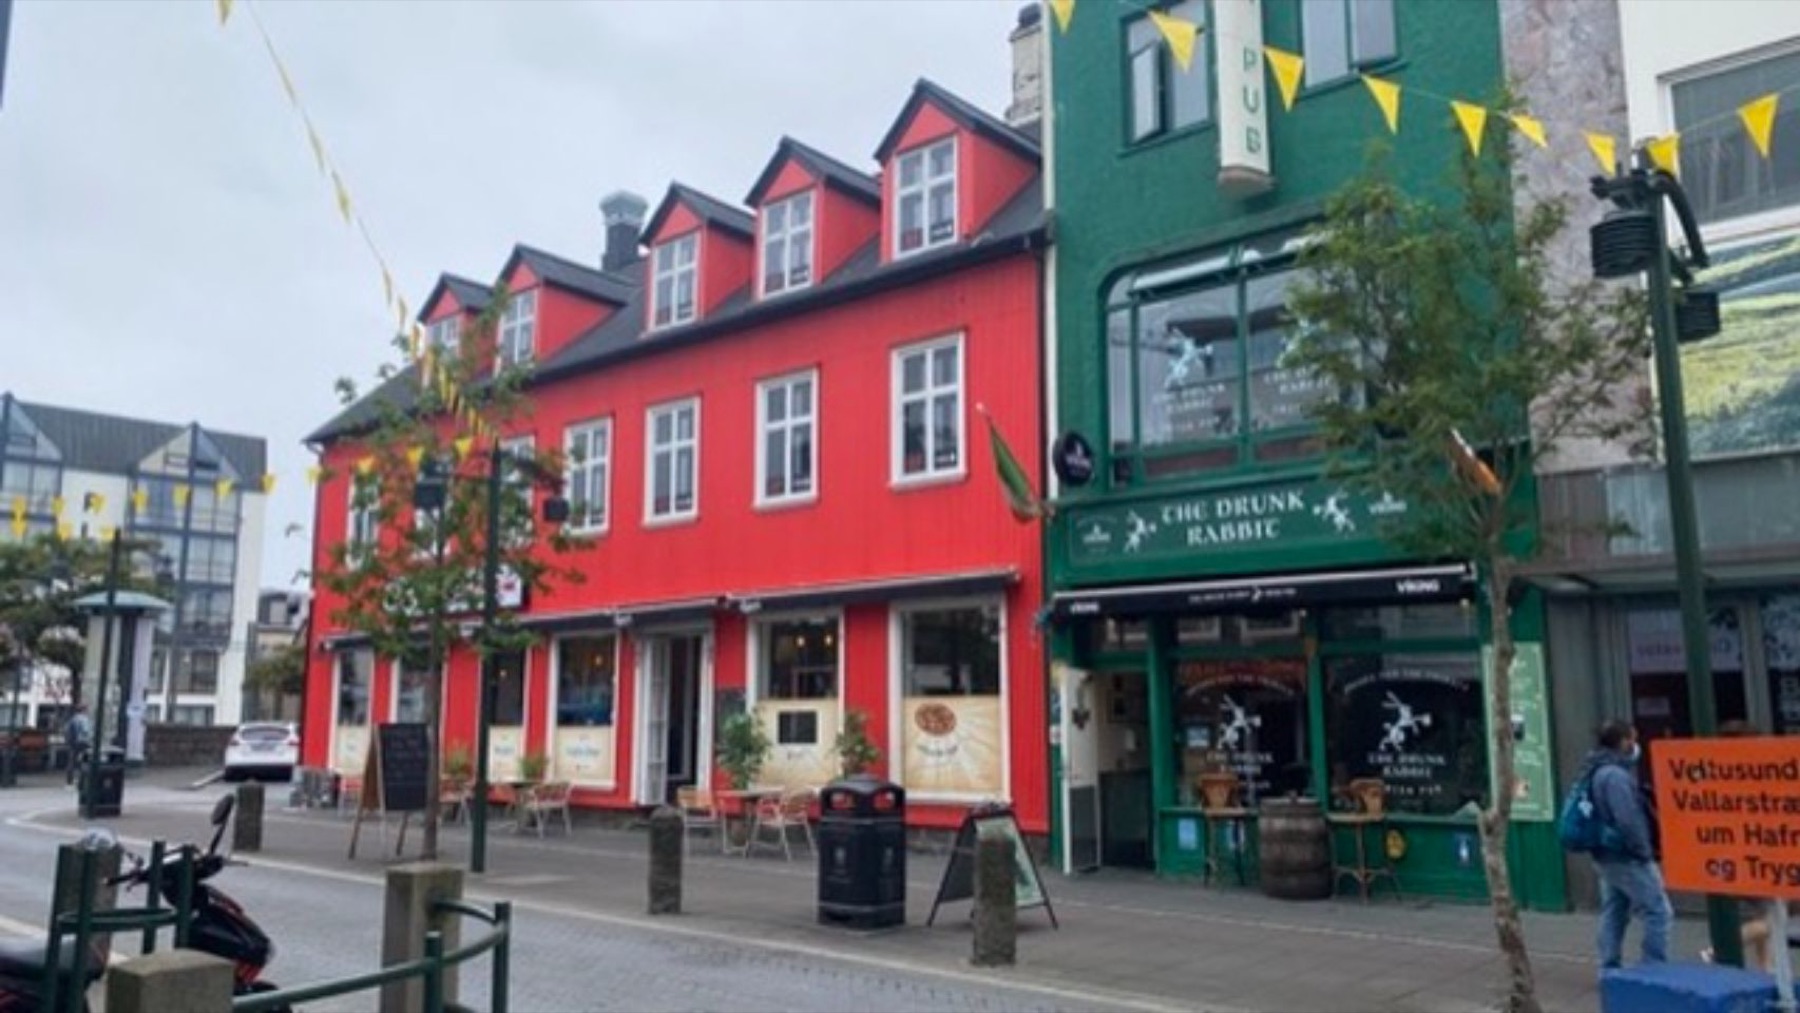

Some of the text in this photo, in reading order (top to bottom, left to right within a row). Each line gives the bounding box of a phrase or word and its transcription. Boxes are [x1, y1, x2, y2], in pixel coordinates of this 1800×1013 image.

[1243, 46, 1261, 153] PUB
[1162, 489, 1305, 524] THE DRUNK
[1187, 518, 1280, 546] RABBIT
[1696, 826, 1735, 845] um
